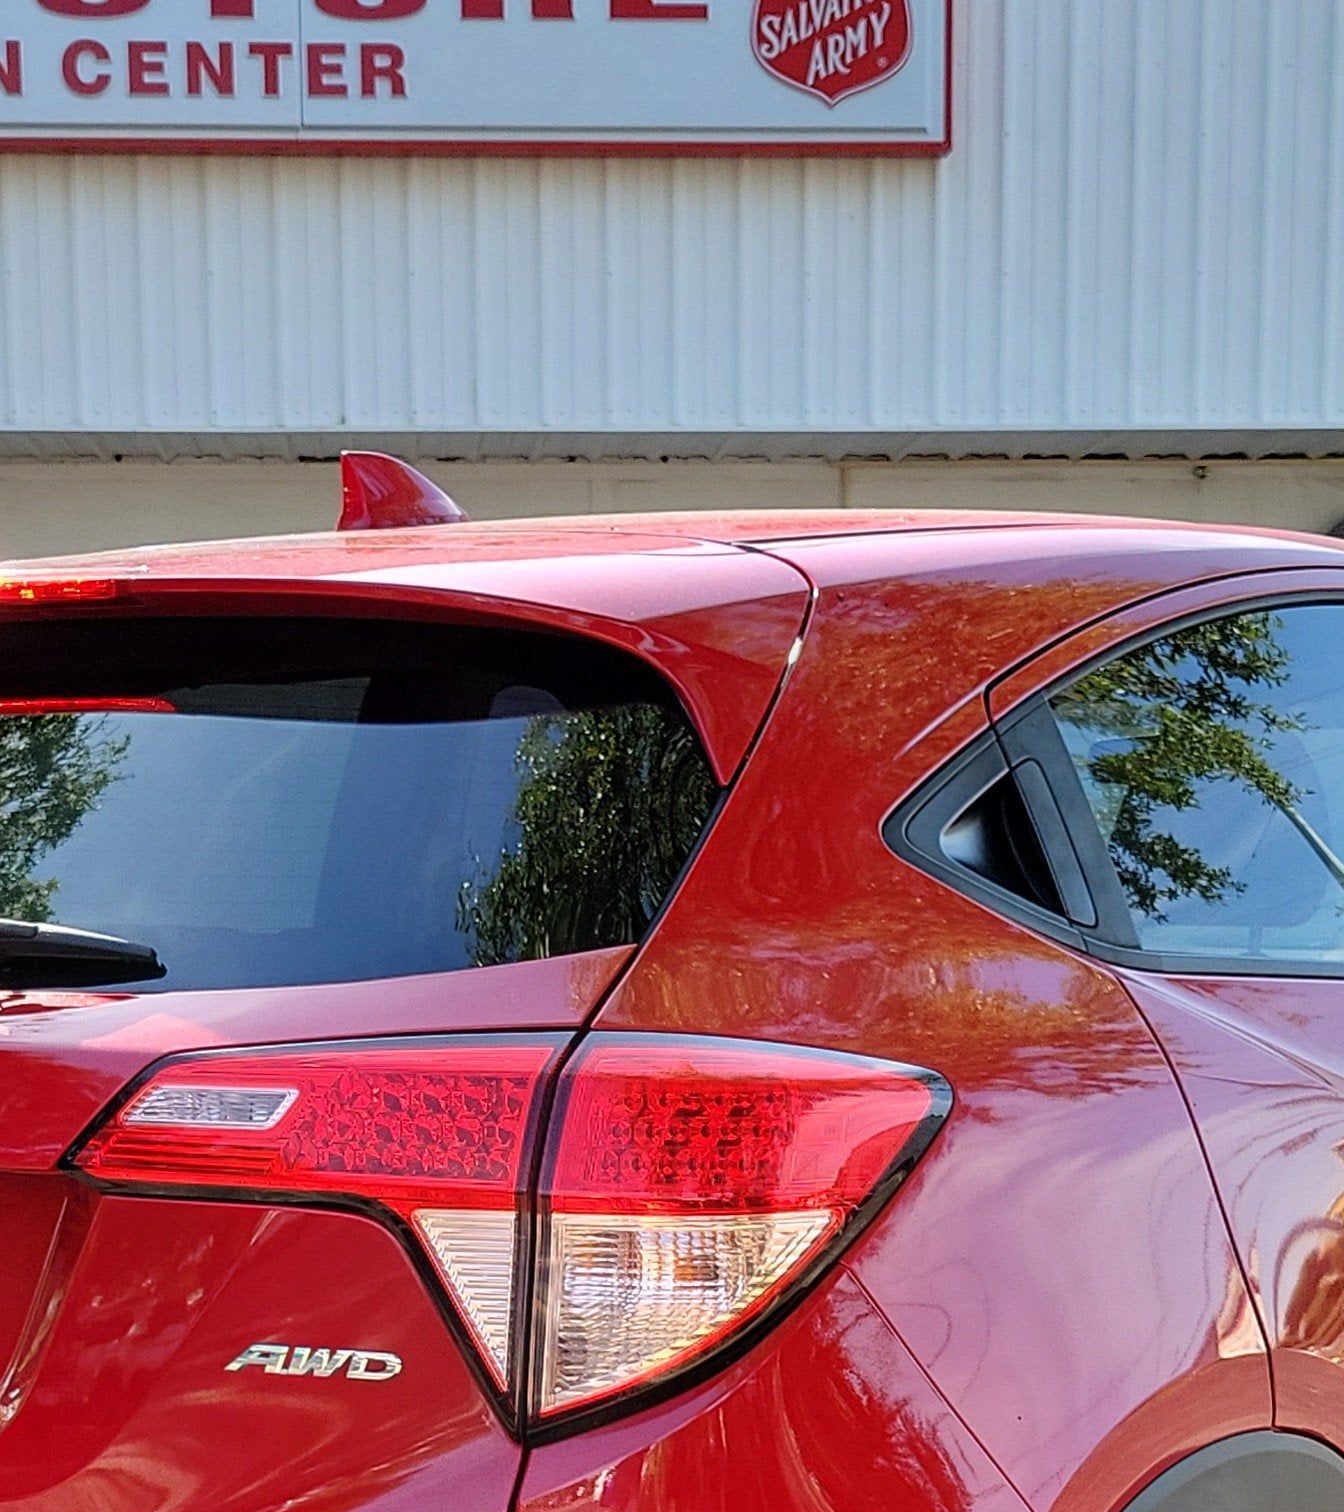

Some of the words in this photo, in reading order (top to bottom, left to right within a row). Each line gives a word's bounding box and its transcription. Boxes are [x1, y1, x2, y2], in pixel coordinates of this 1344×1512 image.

[61, 39, 407, 98] CENTER
[807, 1, 892, 86] ARMY
[224, 1343, 403, 1381] AWD
